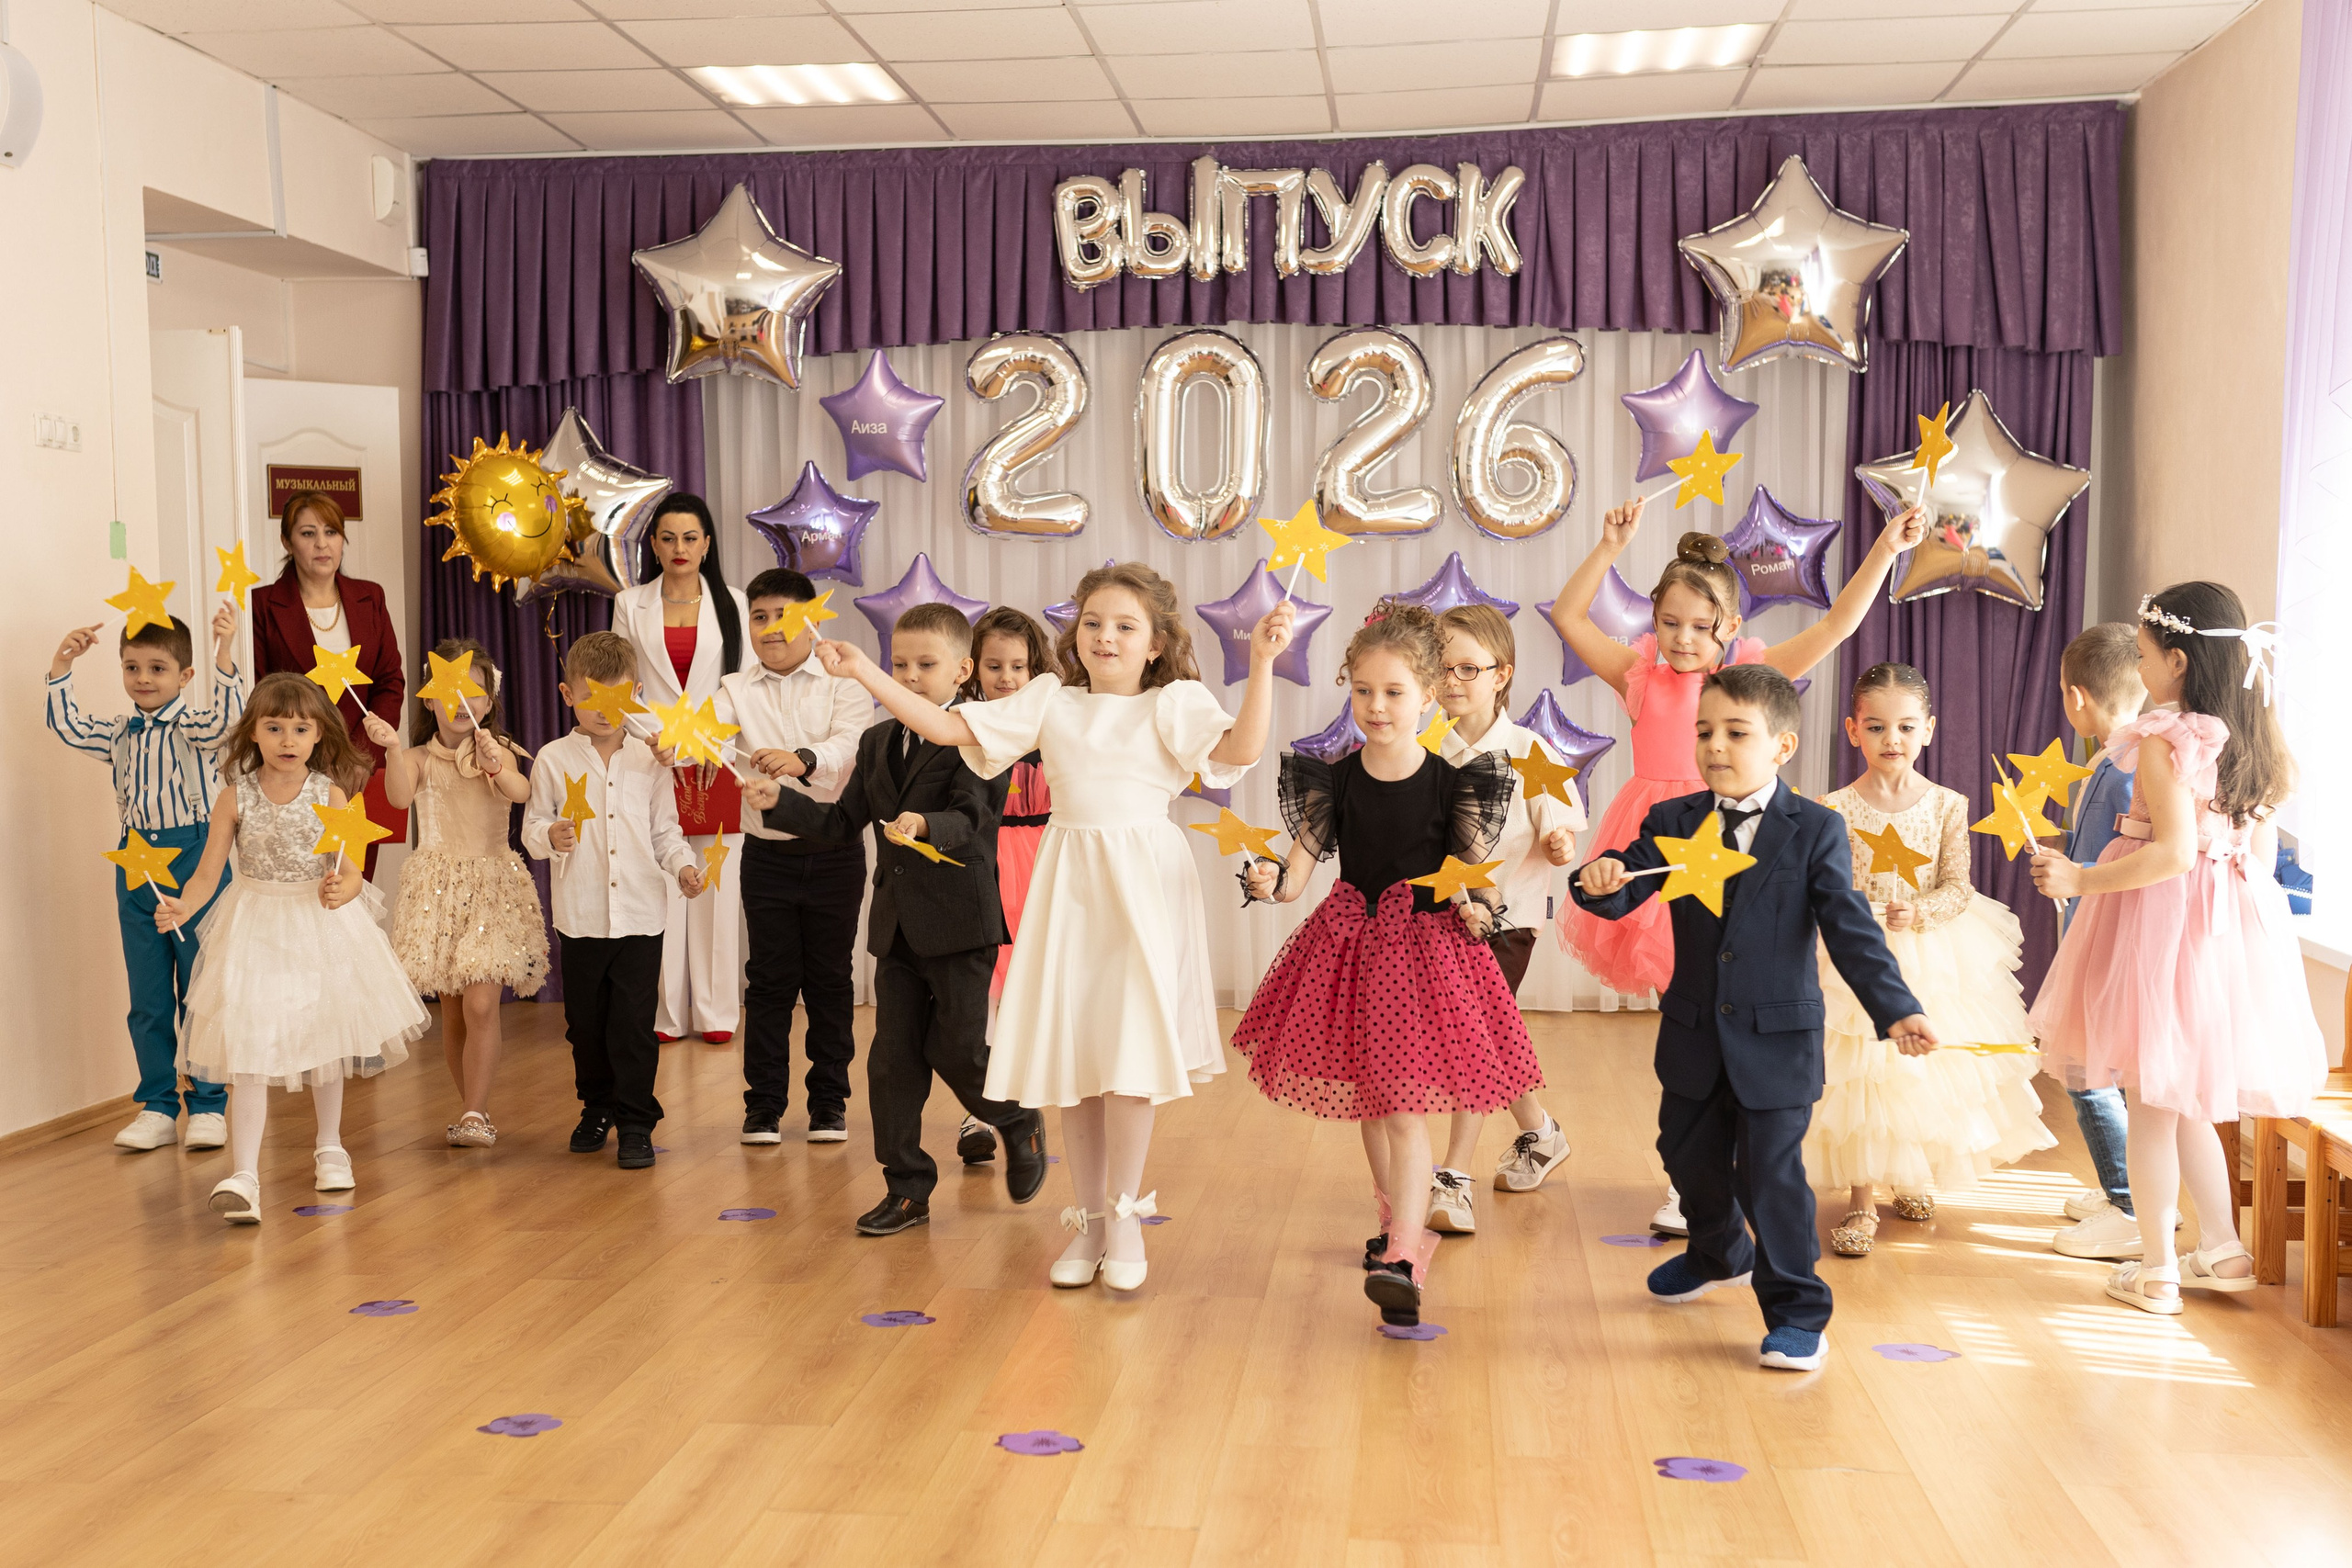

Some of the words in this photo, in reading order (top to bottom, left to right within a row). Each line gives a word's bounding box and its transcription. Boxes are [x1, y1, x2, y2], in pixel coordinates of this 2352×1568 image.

[1054, 154, 1525, 292] ВЫПУСК
[851, 419, 888, 434] Аиза
[960, 326, 1586, 543] 2026
[276, 478, 356, 491] МУЗЫКАЛЬНЫЙ
[801, 530, 842, 544] Арман
[1750, 558, 1795, 576] Роман
